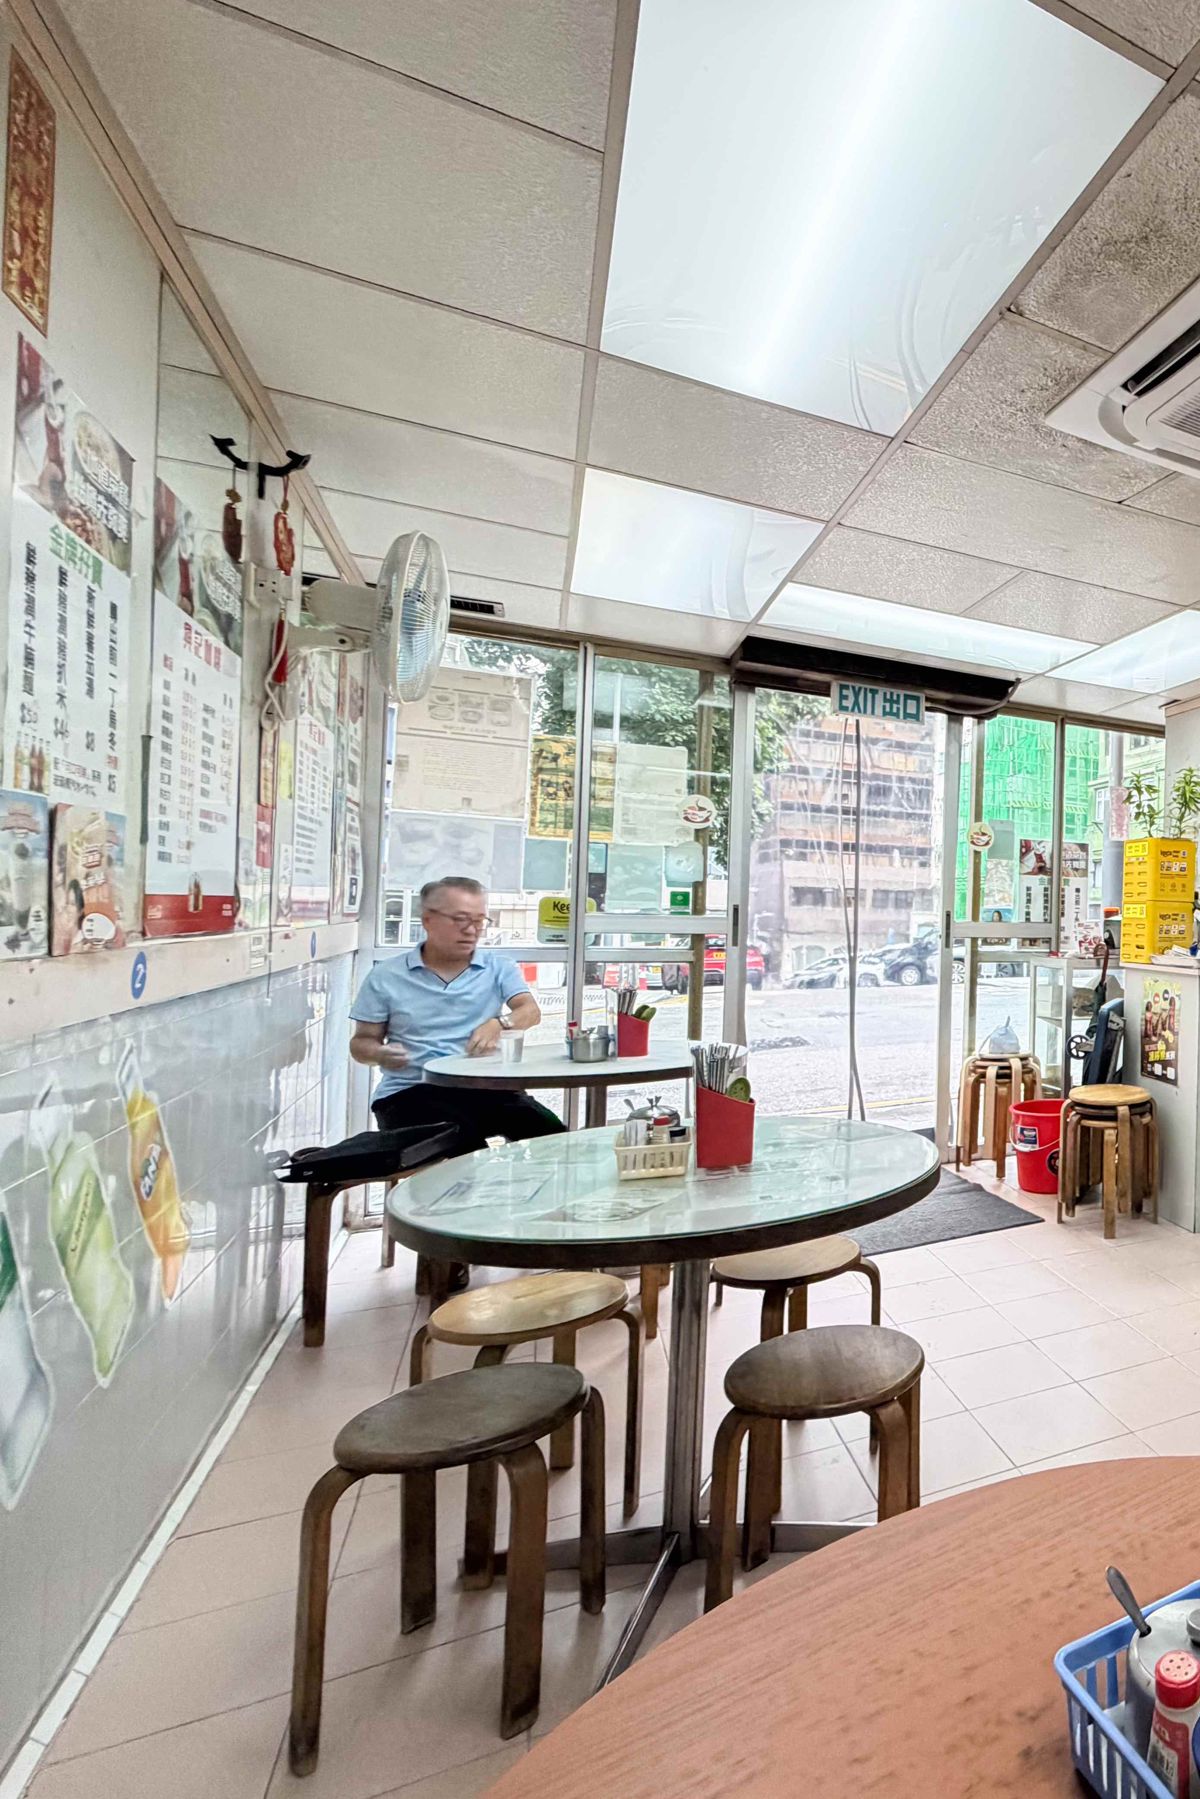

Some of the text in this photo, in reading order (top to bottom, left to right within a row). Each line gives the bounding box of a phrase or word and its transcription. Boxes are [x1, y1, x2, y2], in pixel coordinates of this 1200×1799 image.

[839, 684, 920, 721] EXIT 出口
[135, 964, 144, 988] 2
